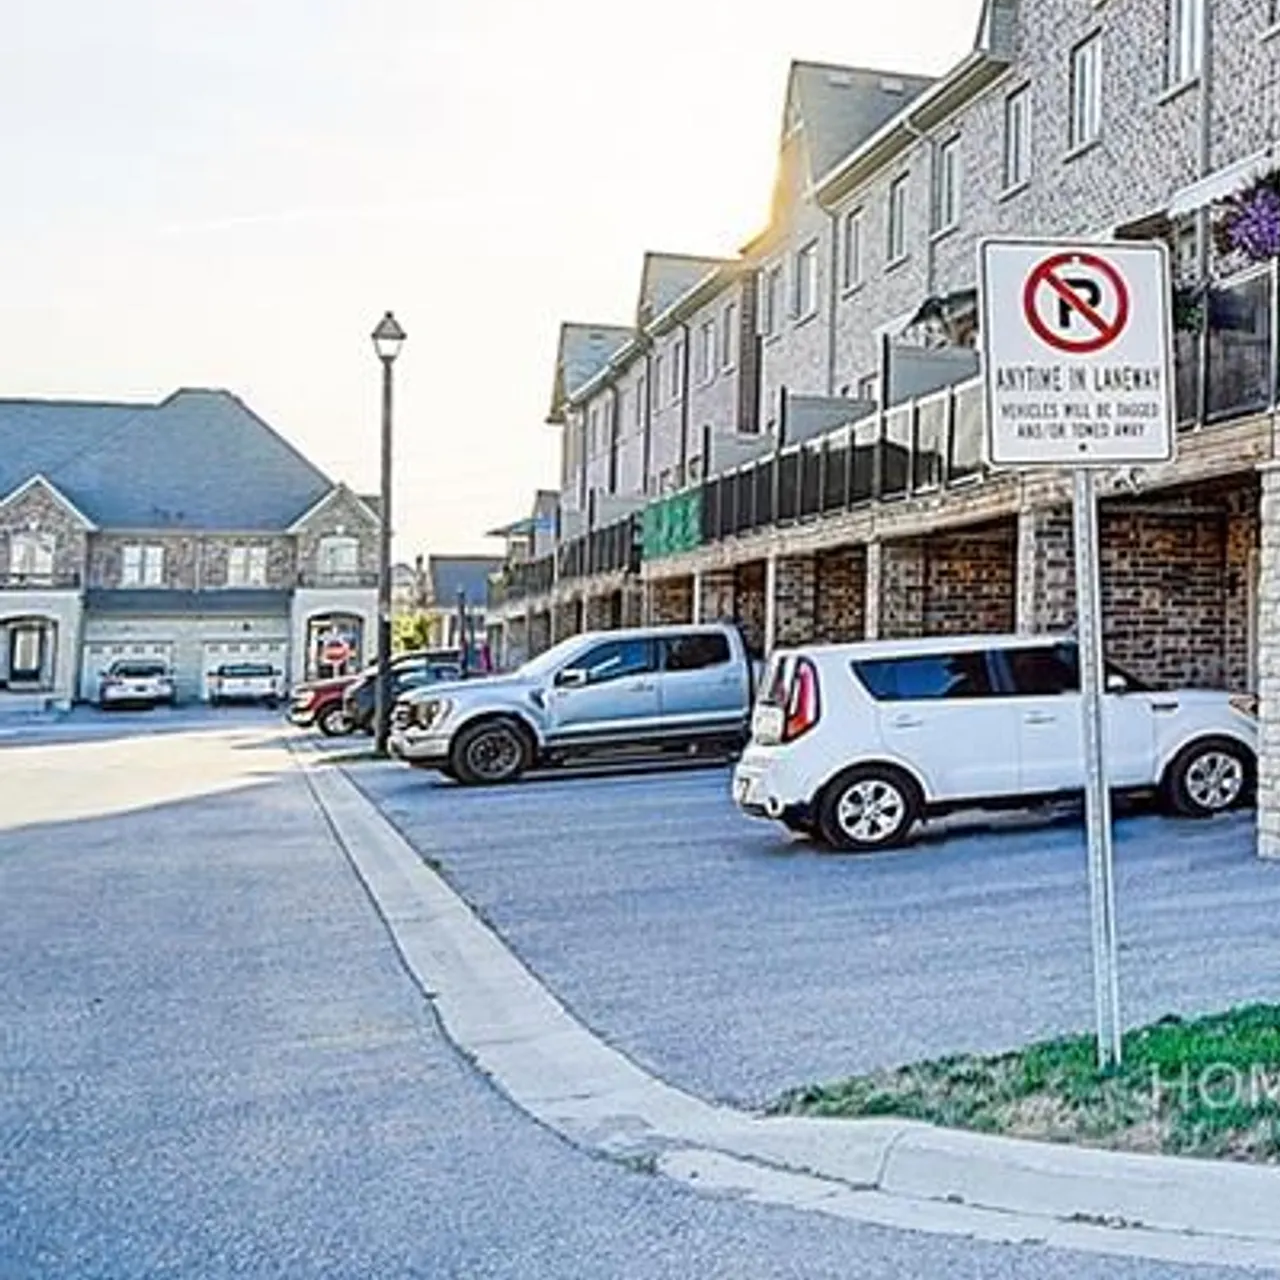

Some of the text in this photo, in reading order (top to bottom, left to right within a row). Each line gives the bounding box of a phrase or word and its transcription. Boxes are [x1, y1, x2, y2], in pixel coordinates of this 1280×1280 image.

[997, 366, 1161, 392] ANYTIME IN LANEWAY
[1001, 402, 1058, 419] VEHICLES
[1065, 402, 1090, 418] WILL
[1097, 402, 1112, 418] BE
[1072, 422, 1110, 440] TOWED
[1114, 421, 1145, 437] AWAY
